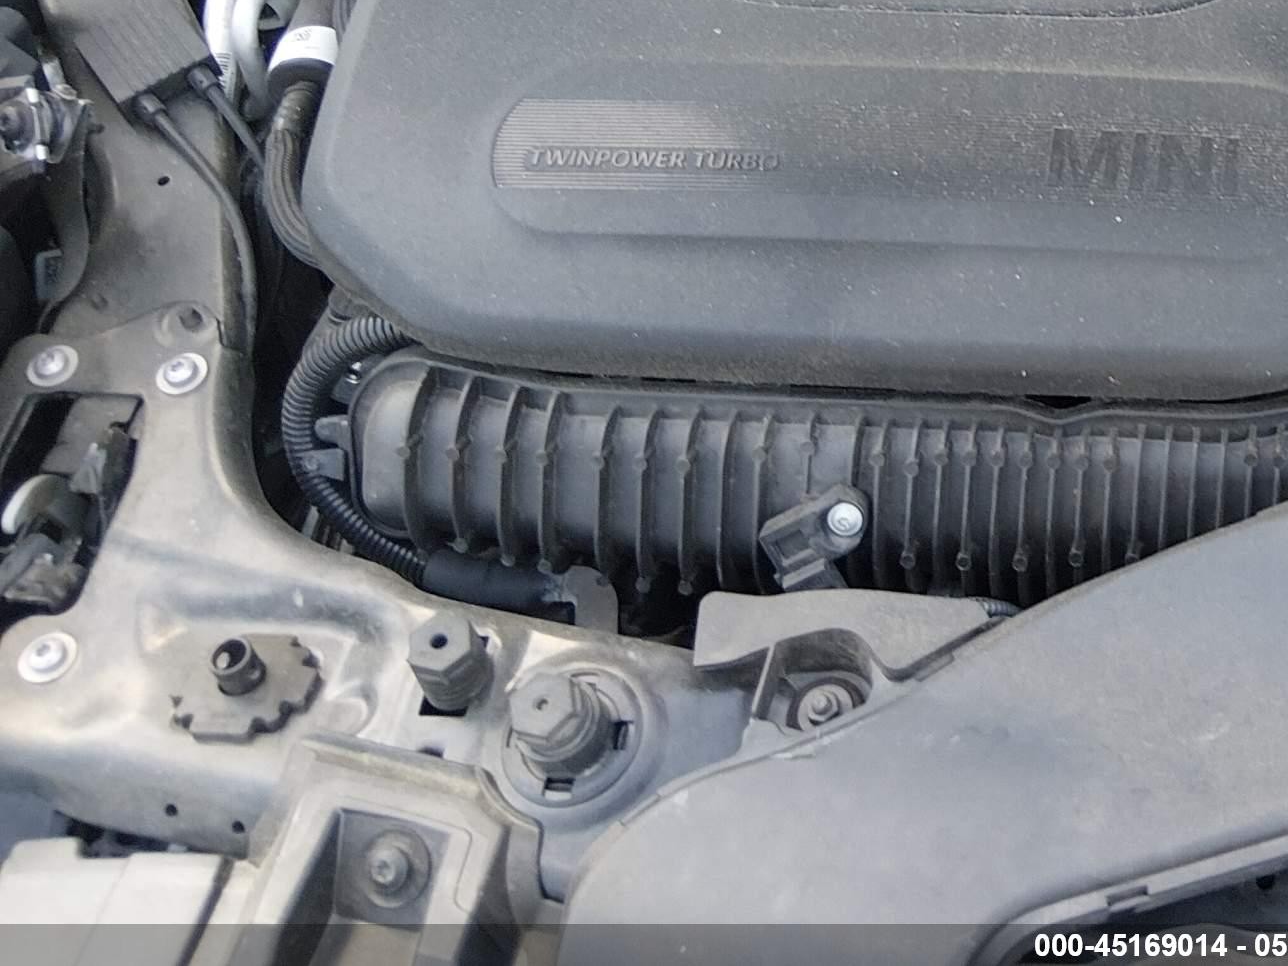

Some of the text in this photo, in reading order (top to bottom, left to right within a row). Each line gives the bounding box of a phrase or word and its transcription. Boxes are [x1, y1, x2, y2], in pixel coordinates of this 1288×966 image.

[528, 146, 781, 172] TWINPOWER TURBO
[1049, 128, 1240, 194] MINI
